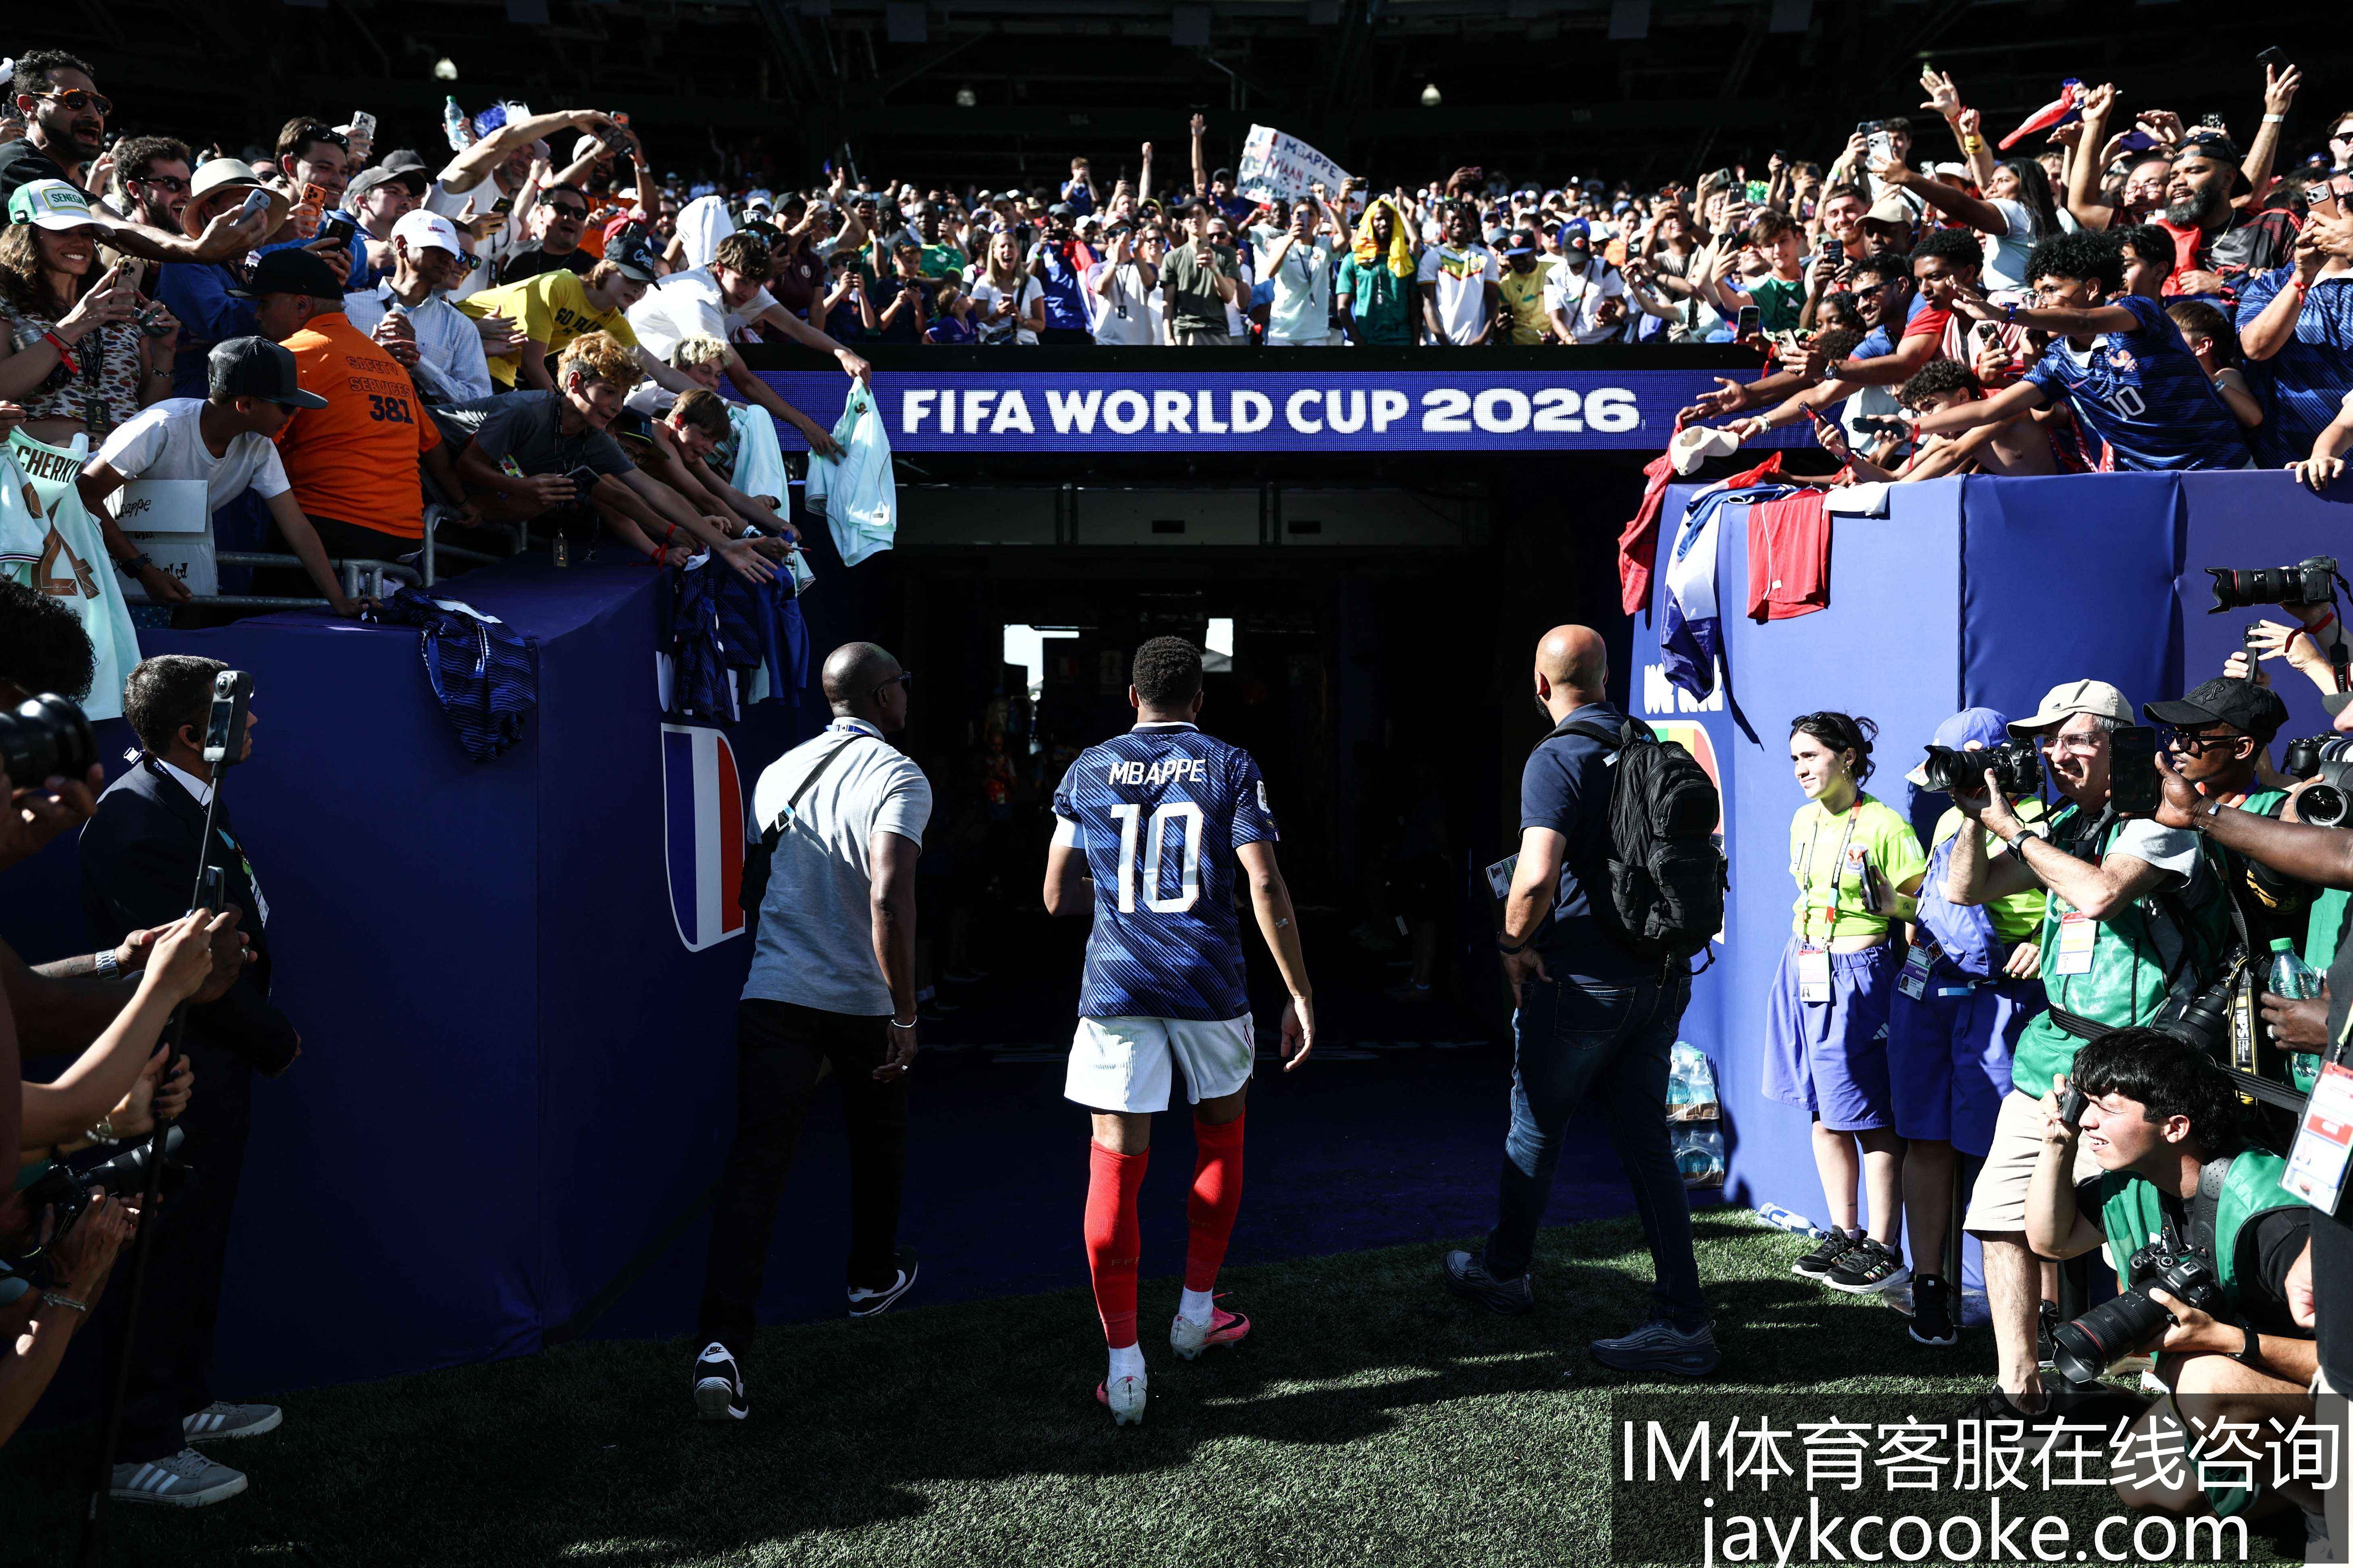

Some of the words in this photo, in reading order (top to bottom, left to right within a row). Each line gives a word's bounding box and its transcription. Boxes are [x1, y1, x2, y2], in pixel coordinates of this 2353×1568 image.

[346, 356, 399, 376] SAFETY
[348, 376, 412, 398] SERVICES
[368, 394, 414, 425] 381
[903, 389, 1035, 434] FIFA
[1045, 389, 1273, 434] WORLD
[1286, 389, 1409, 434] CUP
[1422, 388, 1640, 433] 2026
[2103, 385, 2146, 422] 10
[16, 445, 80, 483] CHERKI
[1108, 758, 1206, 786] MBAPPE
[1110, 801, 1205, 914] 10
[2236, 1009, 2249, 1039] NPS
